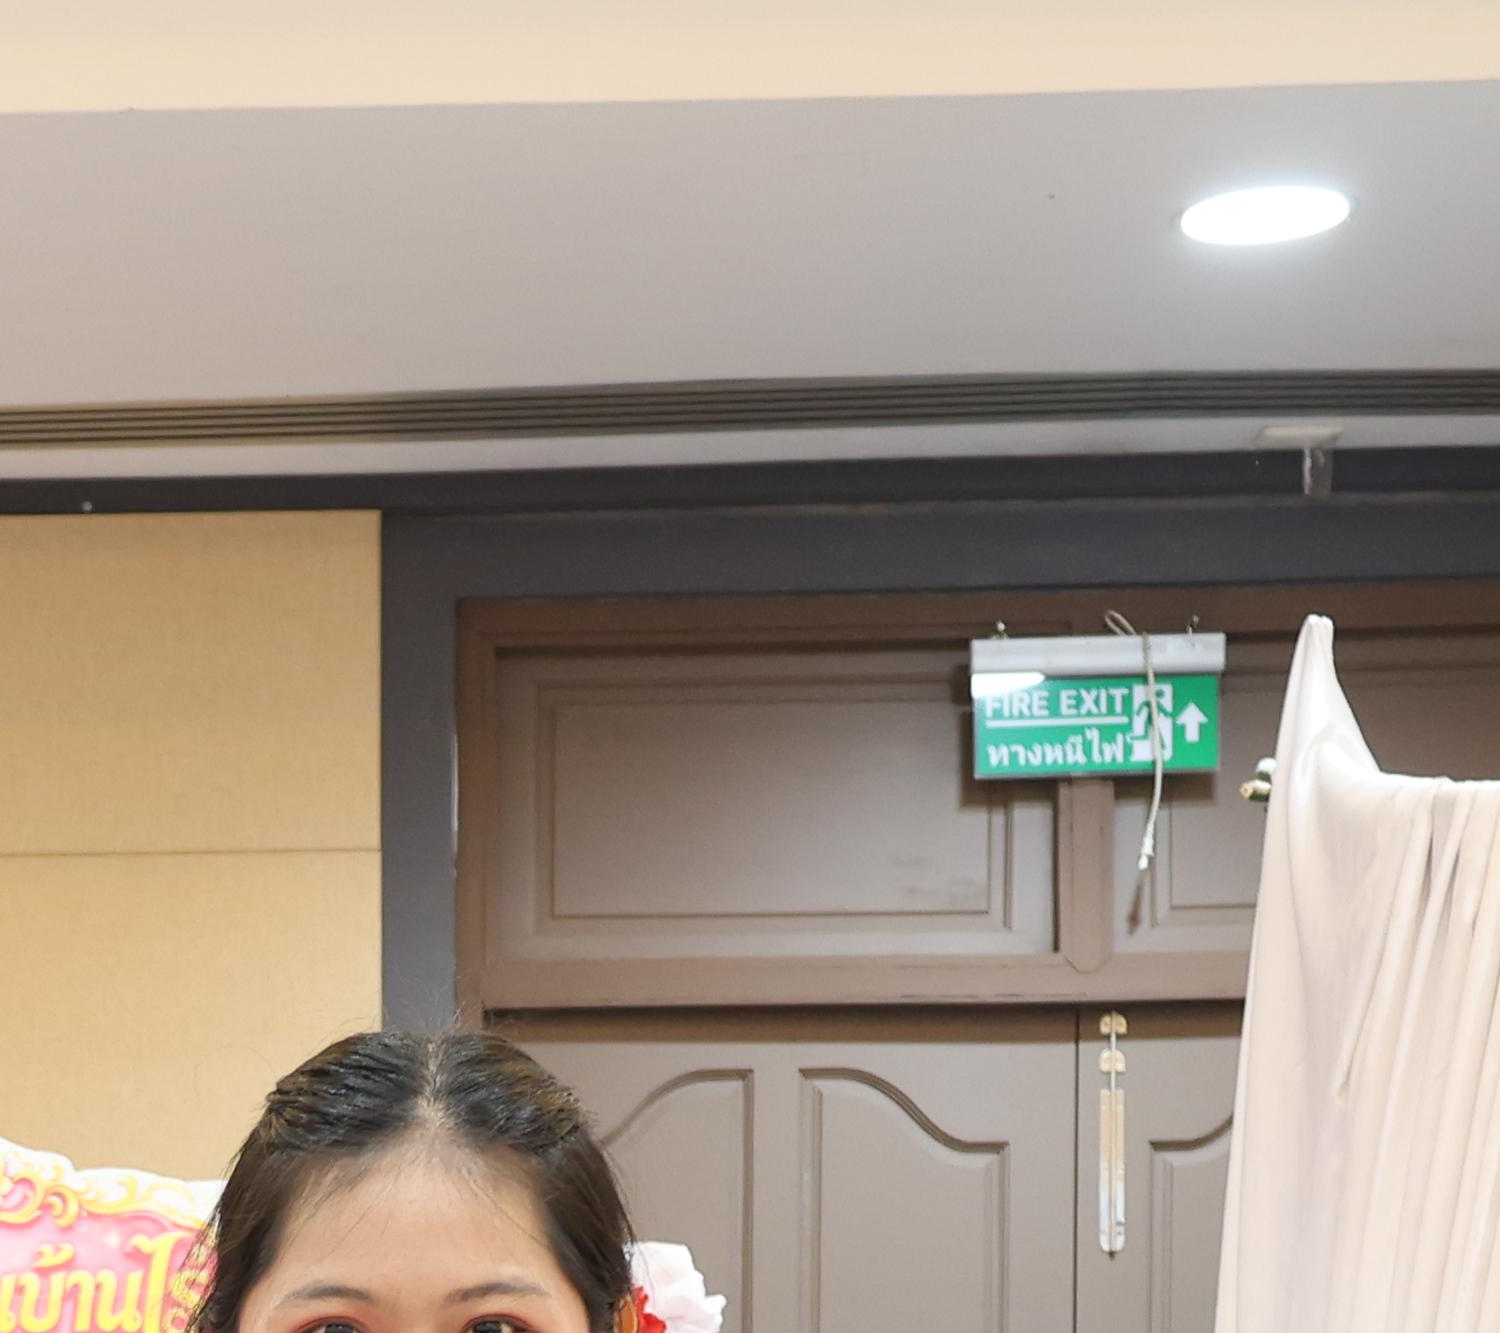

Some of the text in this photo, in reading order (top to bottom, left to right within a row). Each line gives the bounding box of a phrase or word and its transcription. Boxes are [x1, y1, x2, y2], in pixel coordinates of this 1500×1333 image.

[985, 687, 1129, 718] FIRE EXIT
[987, 727, 1127, 767] ทางหนีไฟ
